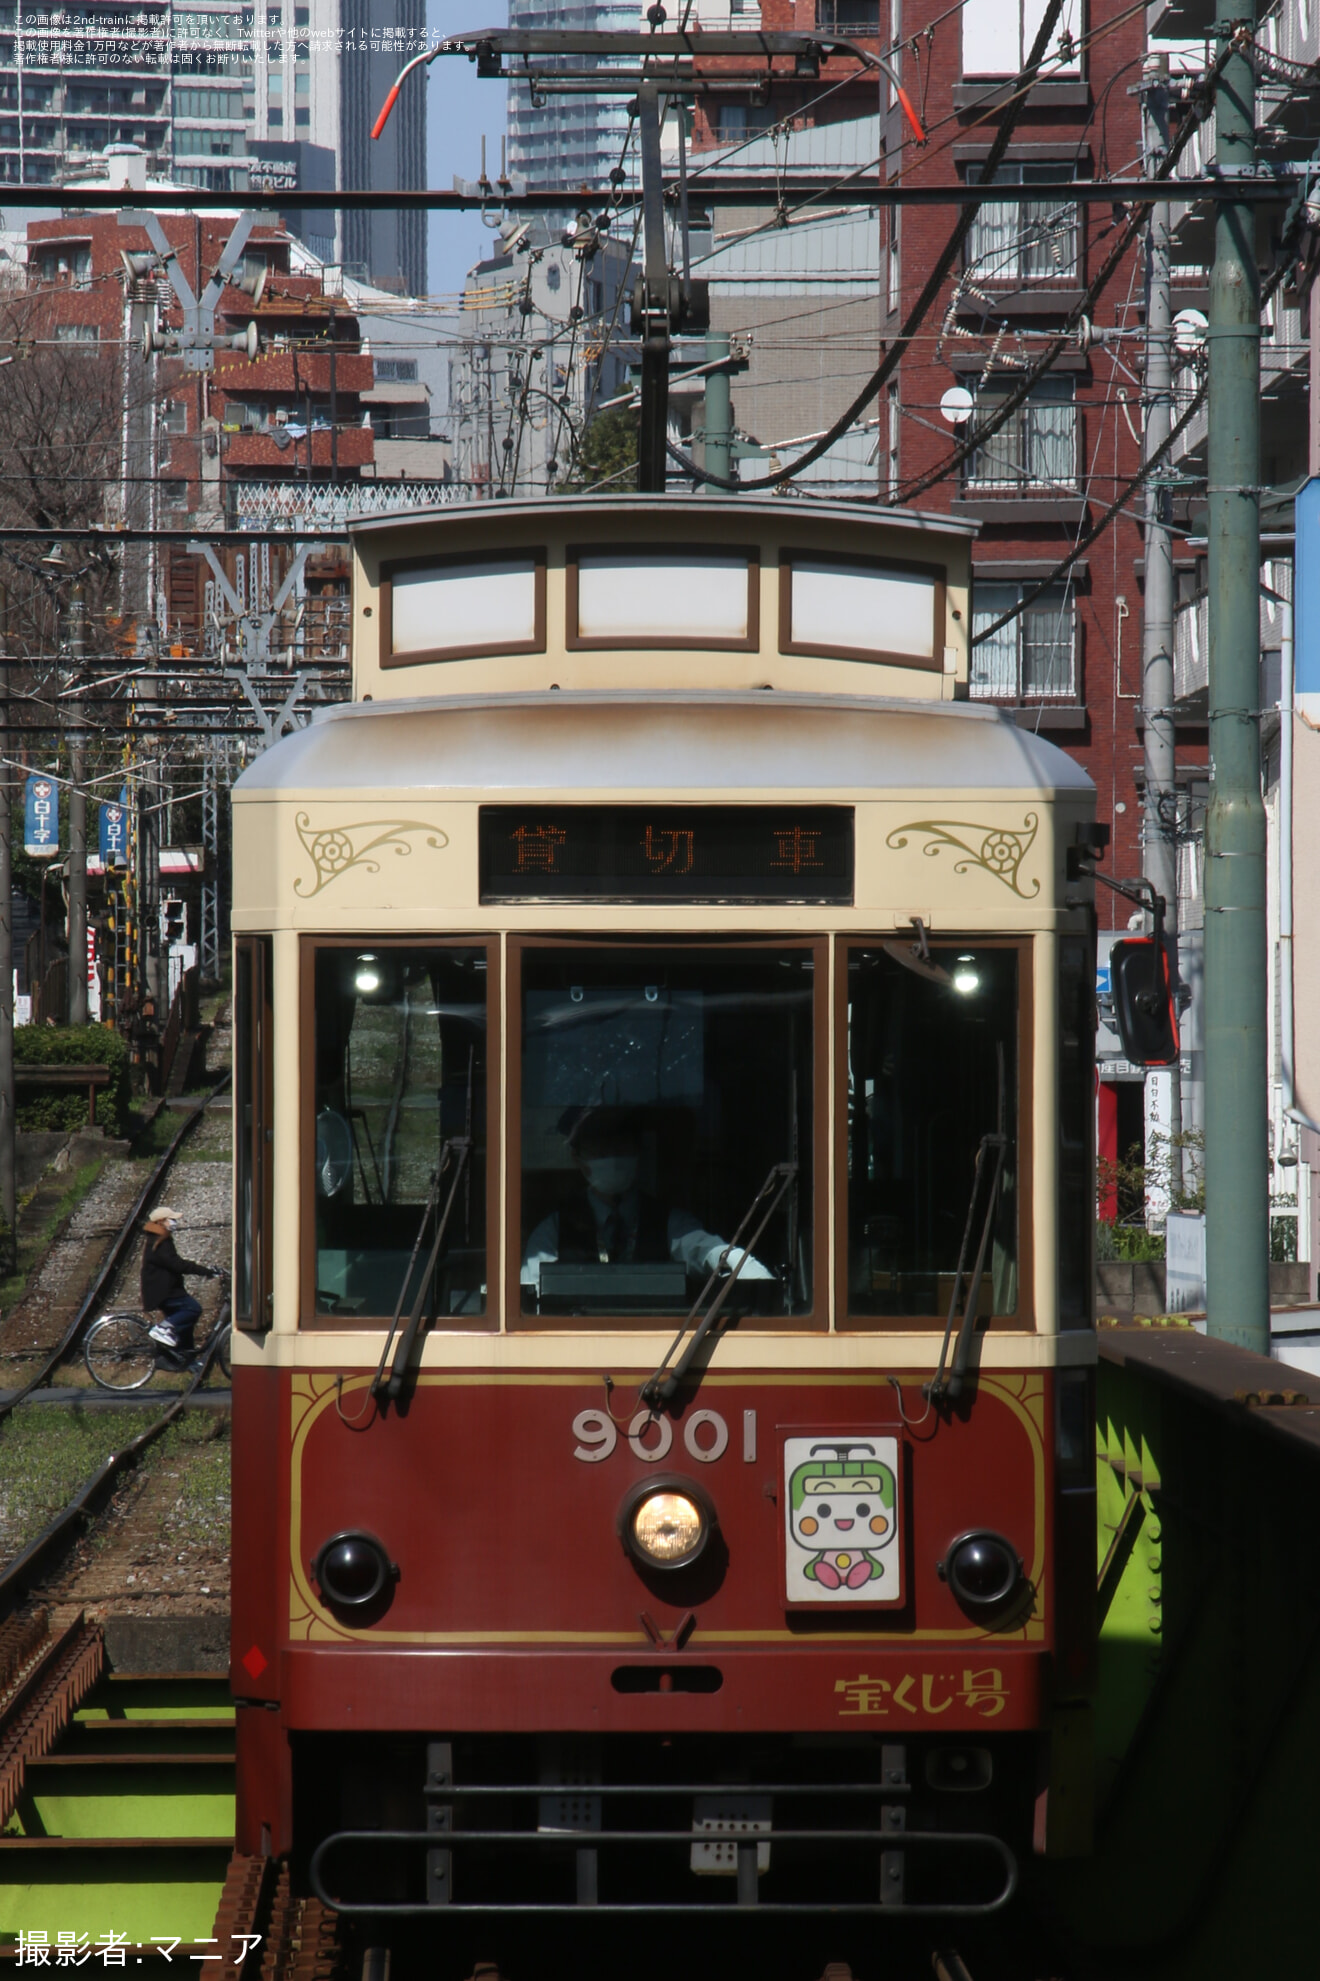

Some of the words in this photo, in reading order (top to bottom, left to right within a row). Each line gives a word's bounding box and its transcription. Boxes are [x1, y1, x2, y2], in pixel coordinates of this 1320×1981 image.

[34, 799, 50, 844] 白十字
[572, 1409, 757, 1463] 9001
[834, 1668, 1010, 1717] 宝くじ号
